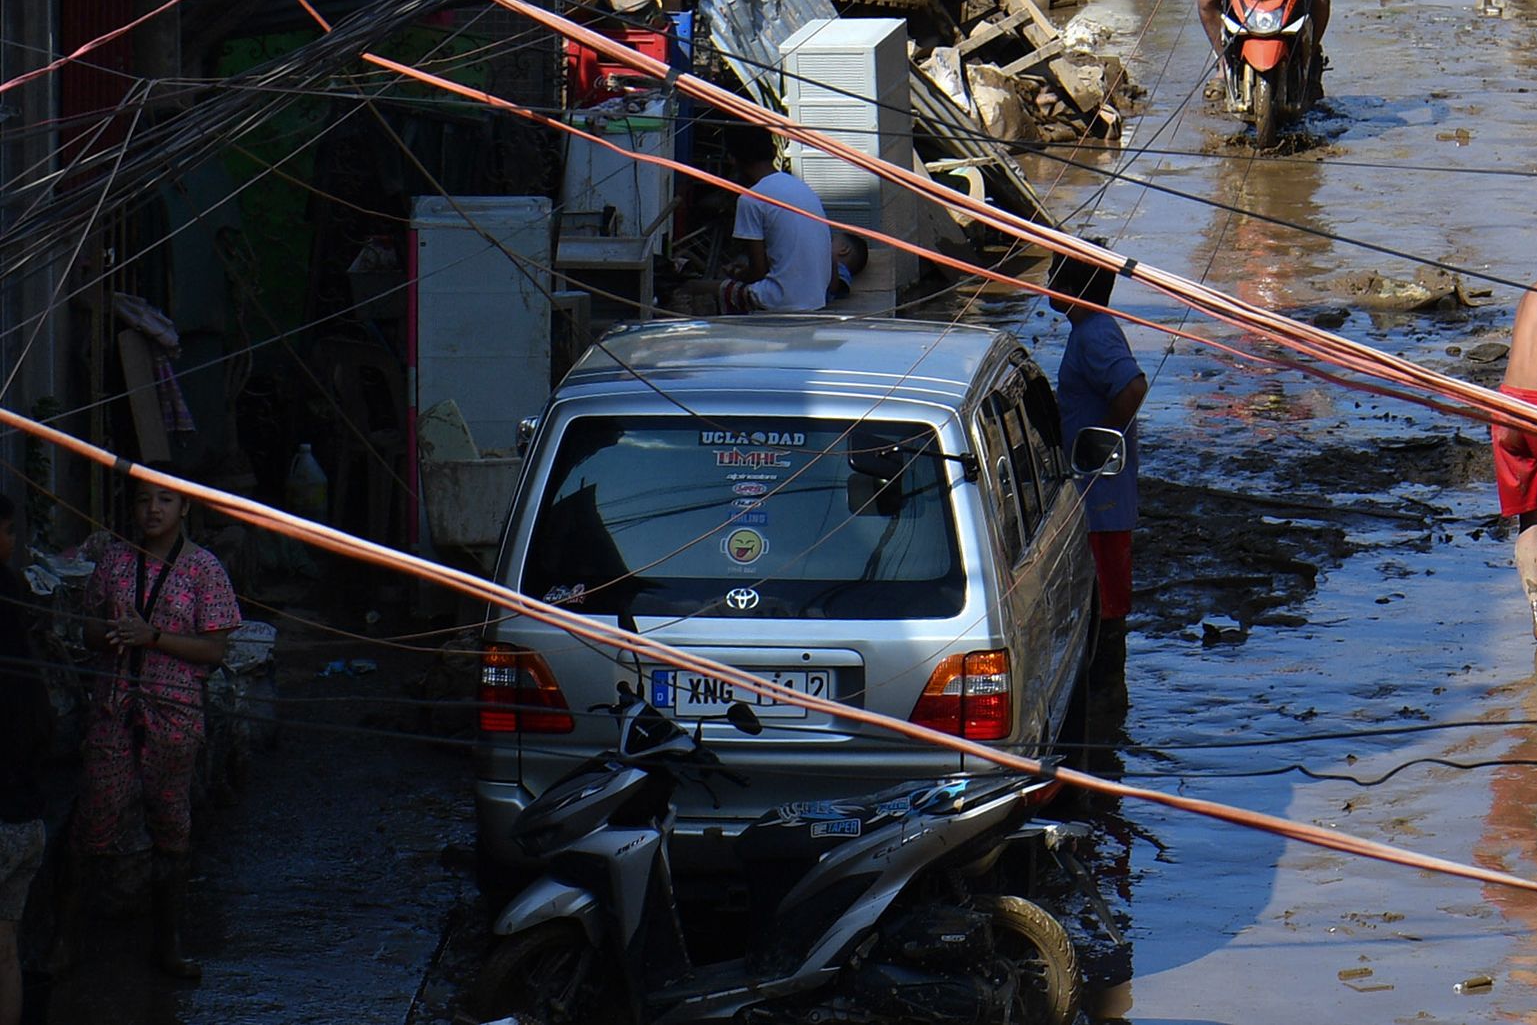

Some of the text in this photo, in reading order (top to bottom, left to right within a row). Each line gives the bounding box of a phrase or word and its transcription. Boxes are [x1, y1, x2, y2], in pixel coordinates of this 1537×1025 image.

[701, 431, 806, 446] UCLA DAD
[687, 677, 734, 705] XNG
